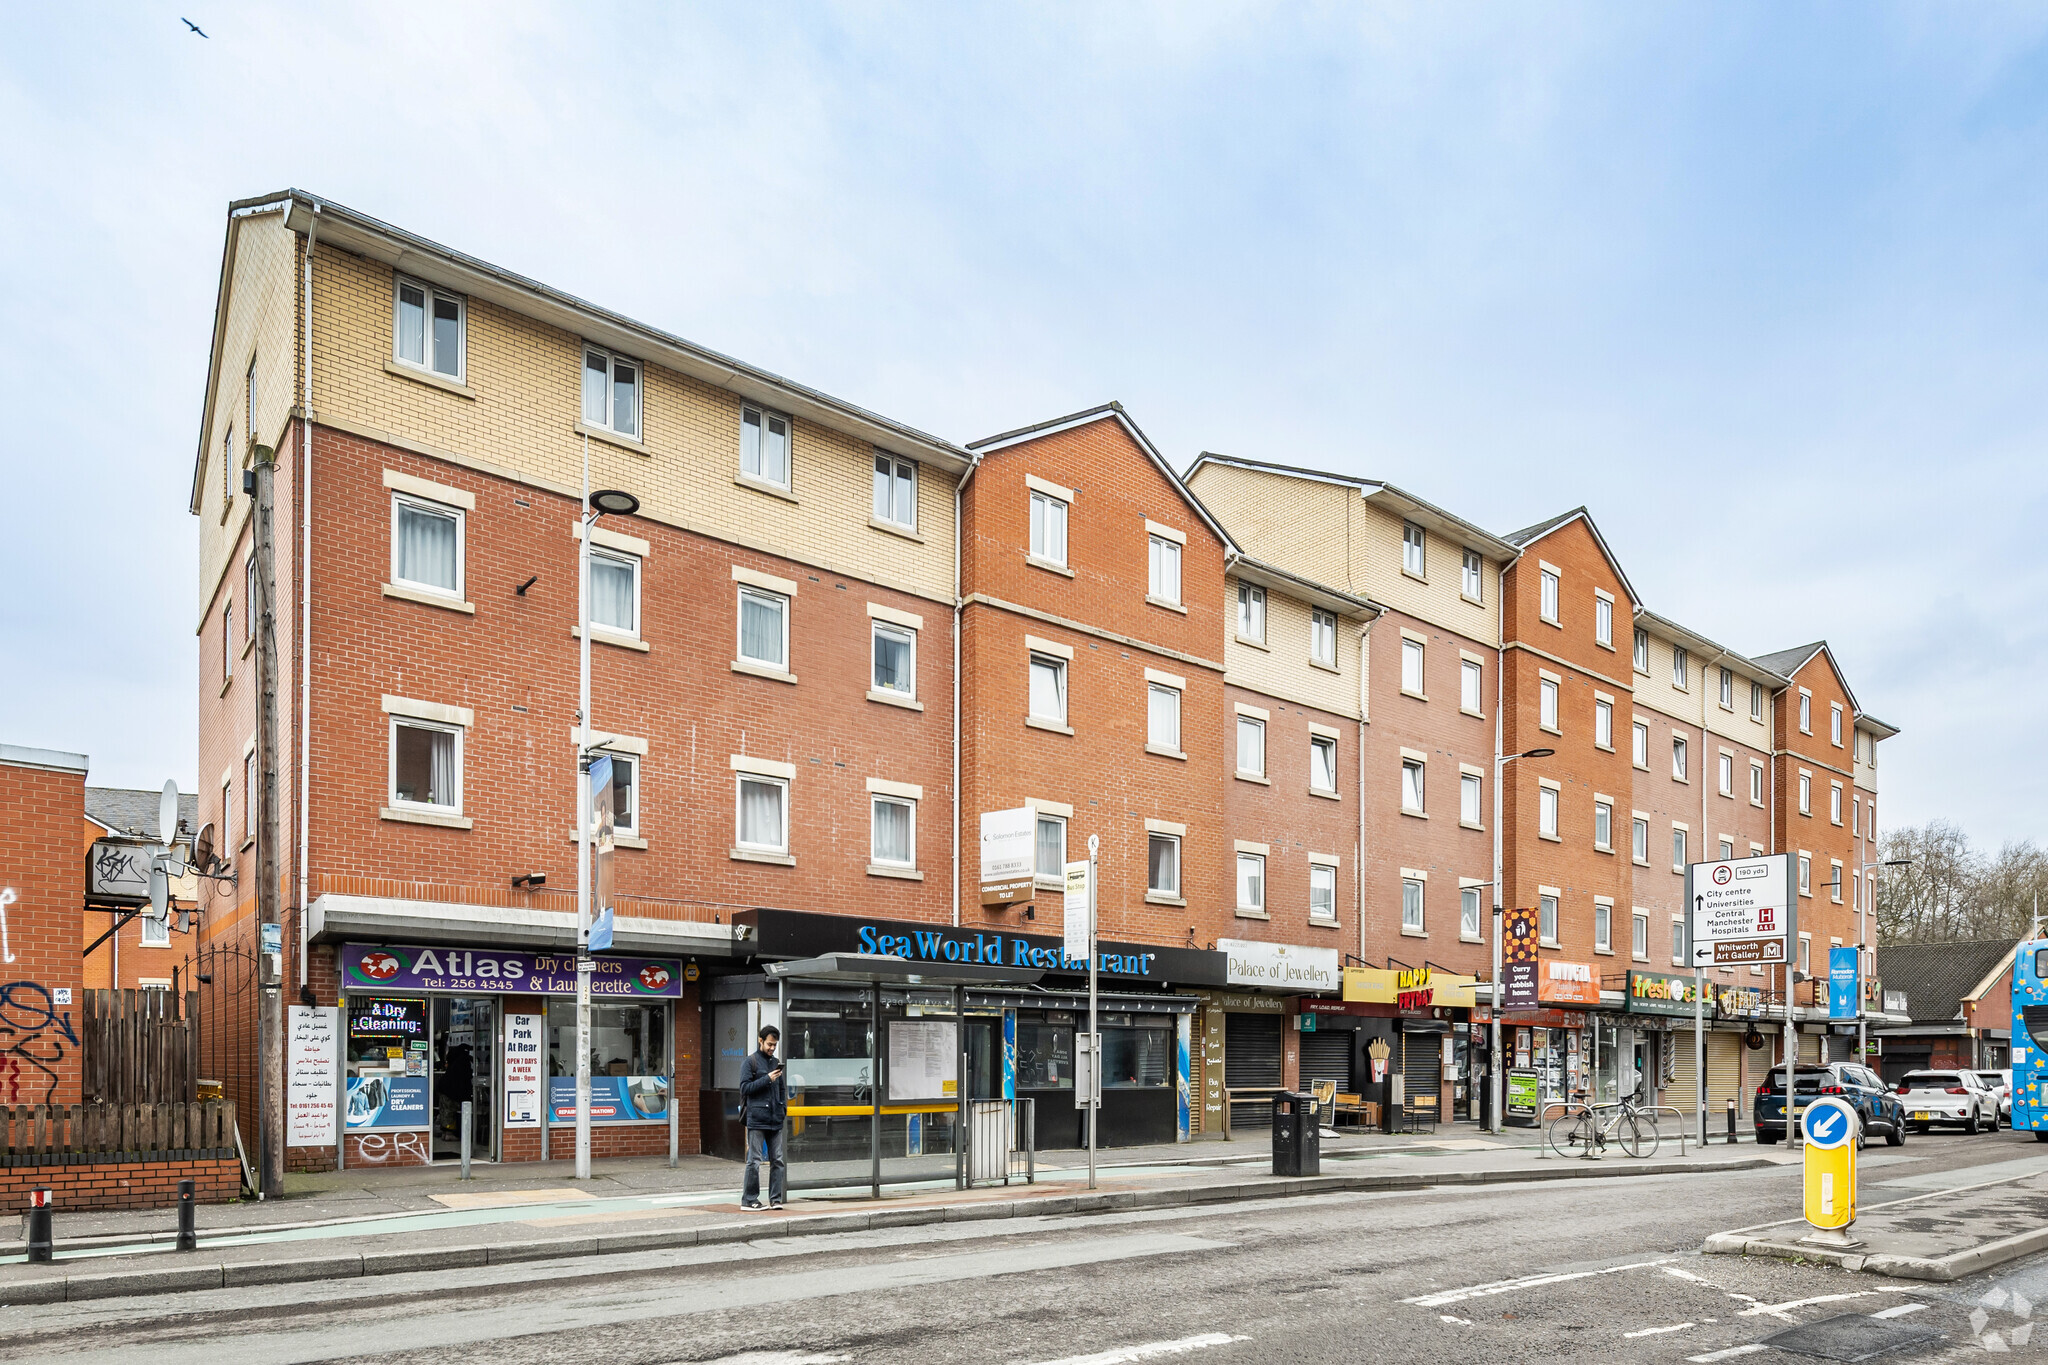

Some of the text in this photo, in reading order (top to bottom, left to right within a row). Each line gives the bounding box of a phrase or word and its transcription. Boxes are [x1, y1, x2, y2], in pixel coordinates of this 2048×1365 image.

[993, 833, 1014, 841] Solomon
[982, 882, 1032, 893] COMMERCIAL PROPERTY
[1726, 888, 1751, 896] centre
[1707, 899, 1754, 909] Universities
[1715, 910, 1745, 918] Central
[1762, 909, 1772, 922] H
[1708, 918, 1754, 927] Manchester
[1712, 926, 1749, 935] Hospitals
[1718, 942, 1759, 951] Whitworth
[1011, 940, 1150, 975] Restrant
[1731, 952, 1760, 960] Gallery
[411, 950, 524, 979] Atlas
[535, 958, 559, 975] Dry
[1229, 958, 1331, 983] Palace of Jewellery
[1398, 968, 1432, 988] HAPPY
[422, 978, 514, 990] Tel: 256 4545
[530, 976, 632, 994] & Lauerette
[1632, 975, 1672, 1000] fresh
[1244, 997, 1252, 1008] of
[1252, 997, 1283, 1012] Jewellery
[1397, 988, 1434, 1011] FRYDAY
[312, 1010, 327, 1020] غسيل
[372, 1003, 407, 1018] & Dry
[515, 1016, 530, 1026] Car
[1547, 1014, 1562, 1023] Centre
[298, 1022, 328, 1031] غسيل عادي
[294, 1034, 309, 1042] البخار
[321, 1034, 331, 1044] كوي
[513, 1029, 532, 1039] Park
[508, 1042, 537, 1052] At Rear
[313, 1057, 330, 1066] تصليح
[295, 1069, 309, 1077] ستائر
[1209, 1078, 1219, 1088] Buy
[1209, 1091, 1219, 1099] Sell
[1206, 1104, 1222, 1113] Repair
[295, 1112, 328, 1120] مواعيد العمل
